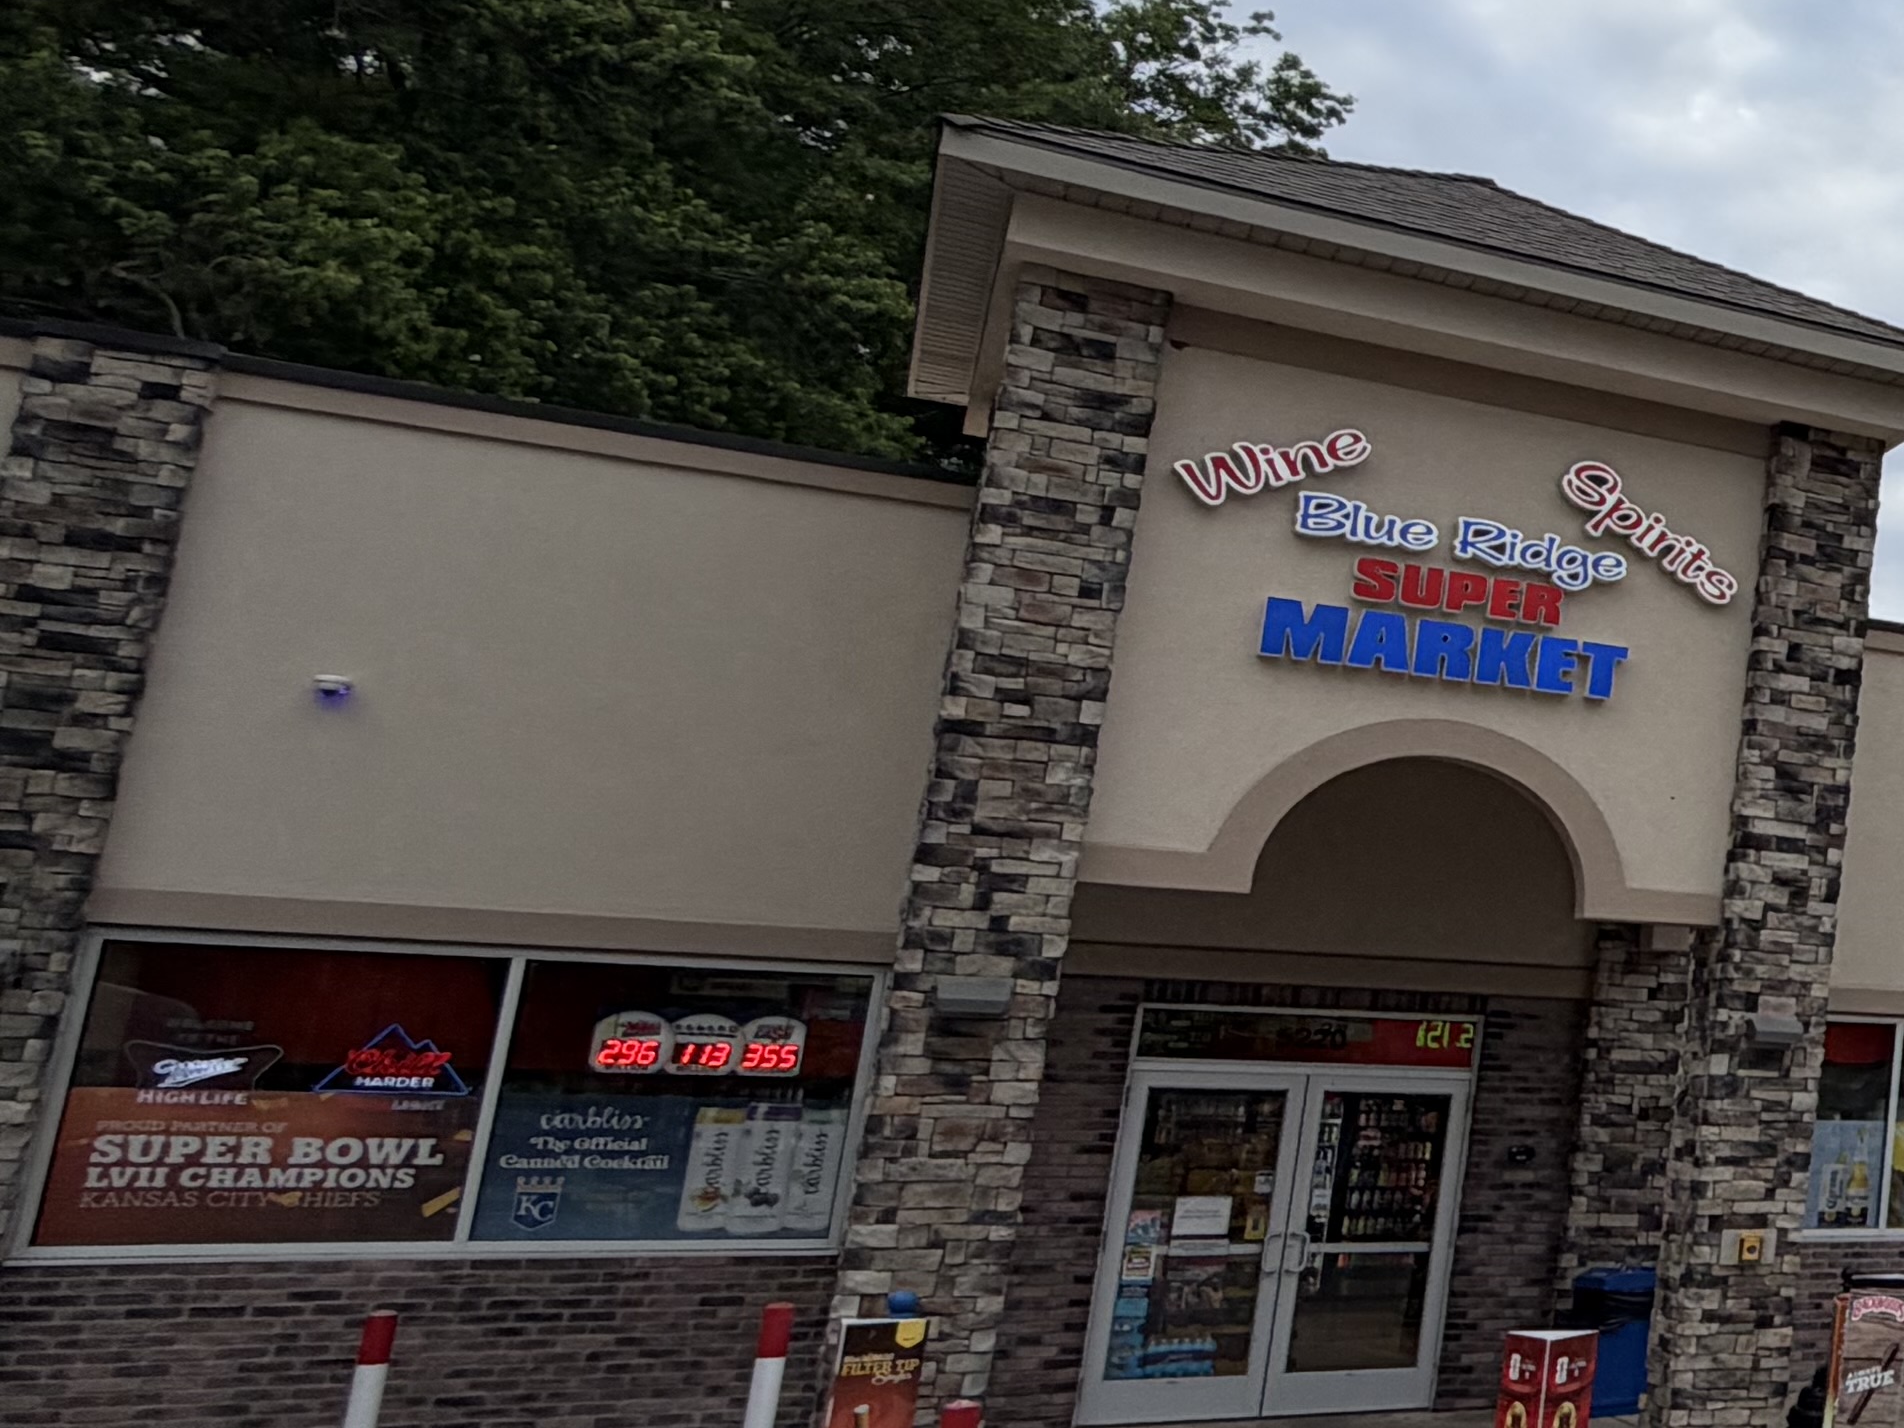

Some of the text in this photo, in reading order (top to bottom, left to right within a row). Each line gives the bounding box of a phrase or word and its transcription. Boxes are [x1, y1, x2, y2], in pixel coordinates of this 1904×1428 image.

[1175, 428, 1372, 506] Wine
[1295, 490, 1627, 591] Blue Ridge
[1561, 460, 1739, 606] Spirits
[1350, 556, 1565, 627] SUPER
[1257, 596, 1629, 700] MARKET
[597, 1039, 660, 1066] 296
[680, 1043, 731, 1068] 113
[740, 1044, 799, 1070] 355
[136, 1089, 248, 1106] HIGH LIFE
[95, 1120, 167, 1133] PROUD
[169, 1120, 258, 1133] PARTNER
[88, 1134, 445, 1166] SUPER BOWL
[529, 1136, 649, 1153] The Official
[499, 1154, 671, 1170] Canned Cocktail
[84, 1166, 417, 1189] LVII CHAMPIONS
[79, 1190, 382, 1209] KANSAS CITY HIEFS
[516, 1194, 554, 1222] KC
[840, 1358, 921, 1377] FILTER TIP
[1844, 1369, 1895, 1395] TRUE
